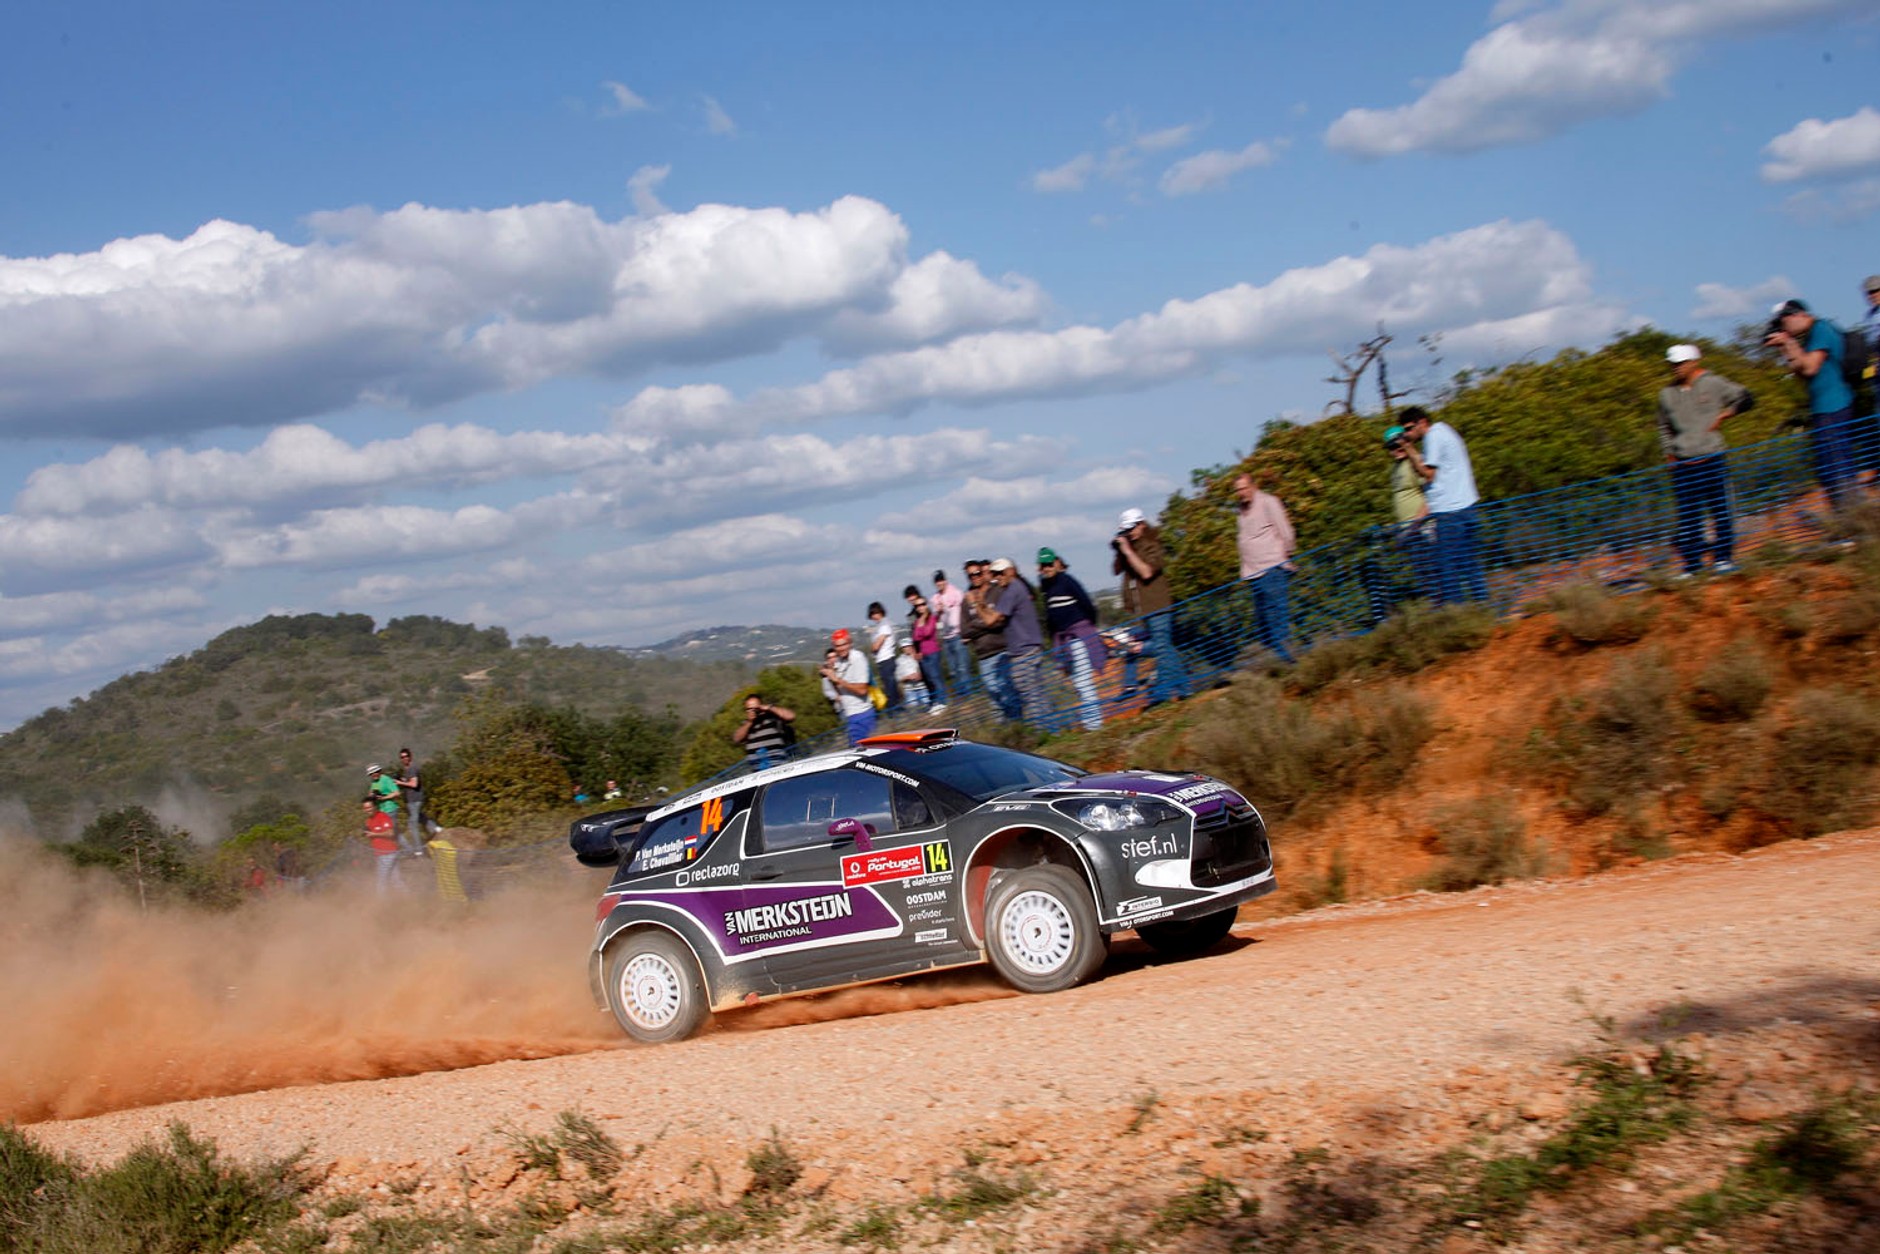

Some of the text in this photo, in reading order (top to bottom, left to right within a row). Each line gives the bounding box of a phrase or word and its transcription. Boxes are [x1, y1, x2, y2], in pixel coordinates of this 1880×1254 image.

[855, 761, 920, 788] VM-MOTORSPORT.COM
[700, 796, 723, 835] 14
[926, 843, 948, 873] 14
[1121, 832, 1178, 859] stef.nl
[690, 863, 740, 882] reclazorg
[868, 856, 920, 872] Portugal
[906, 890, 947, 905] OOSTDAM
[725, 912, 737, 935] VAN
[734, 892, 852, 934] MERKSTEIJN
[740, 926, 812, 944] INTERNATIONAL
